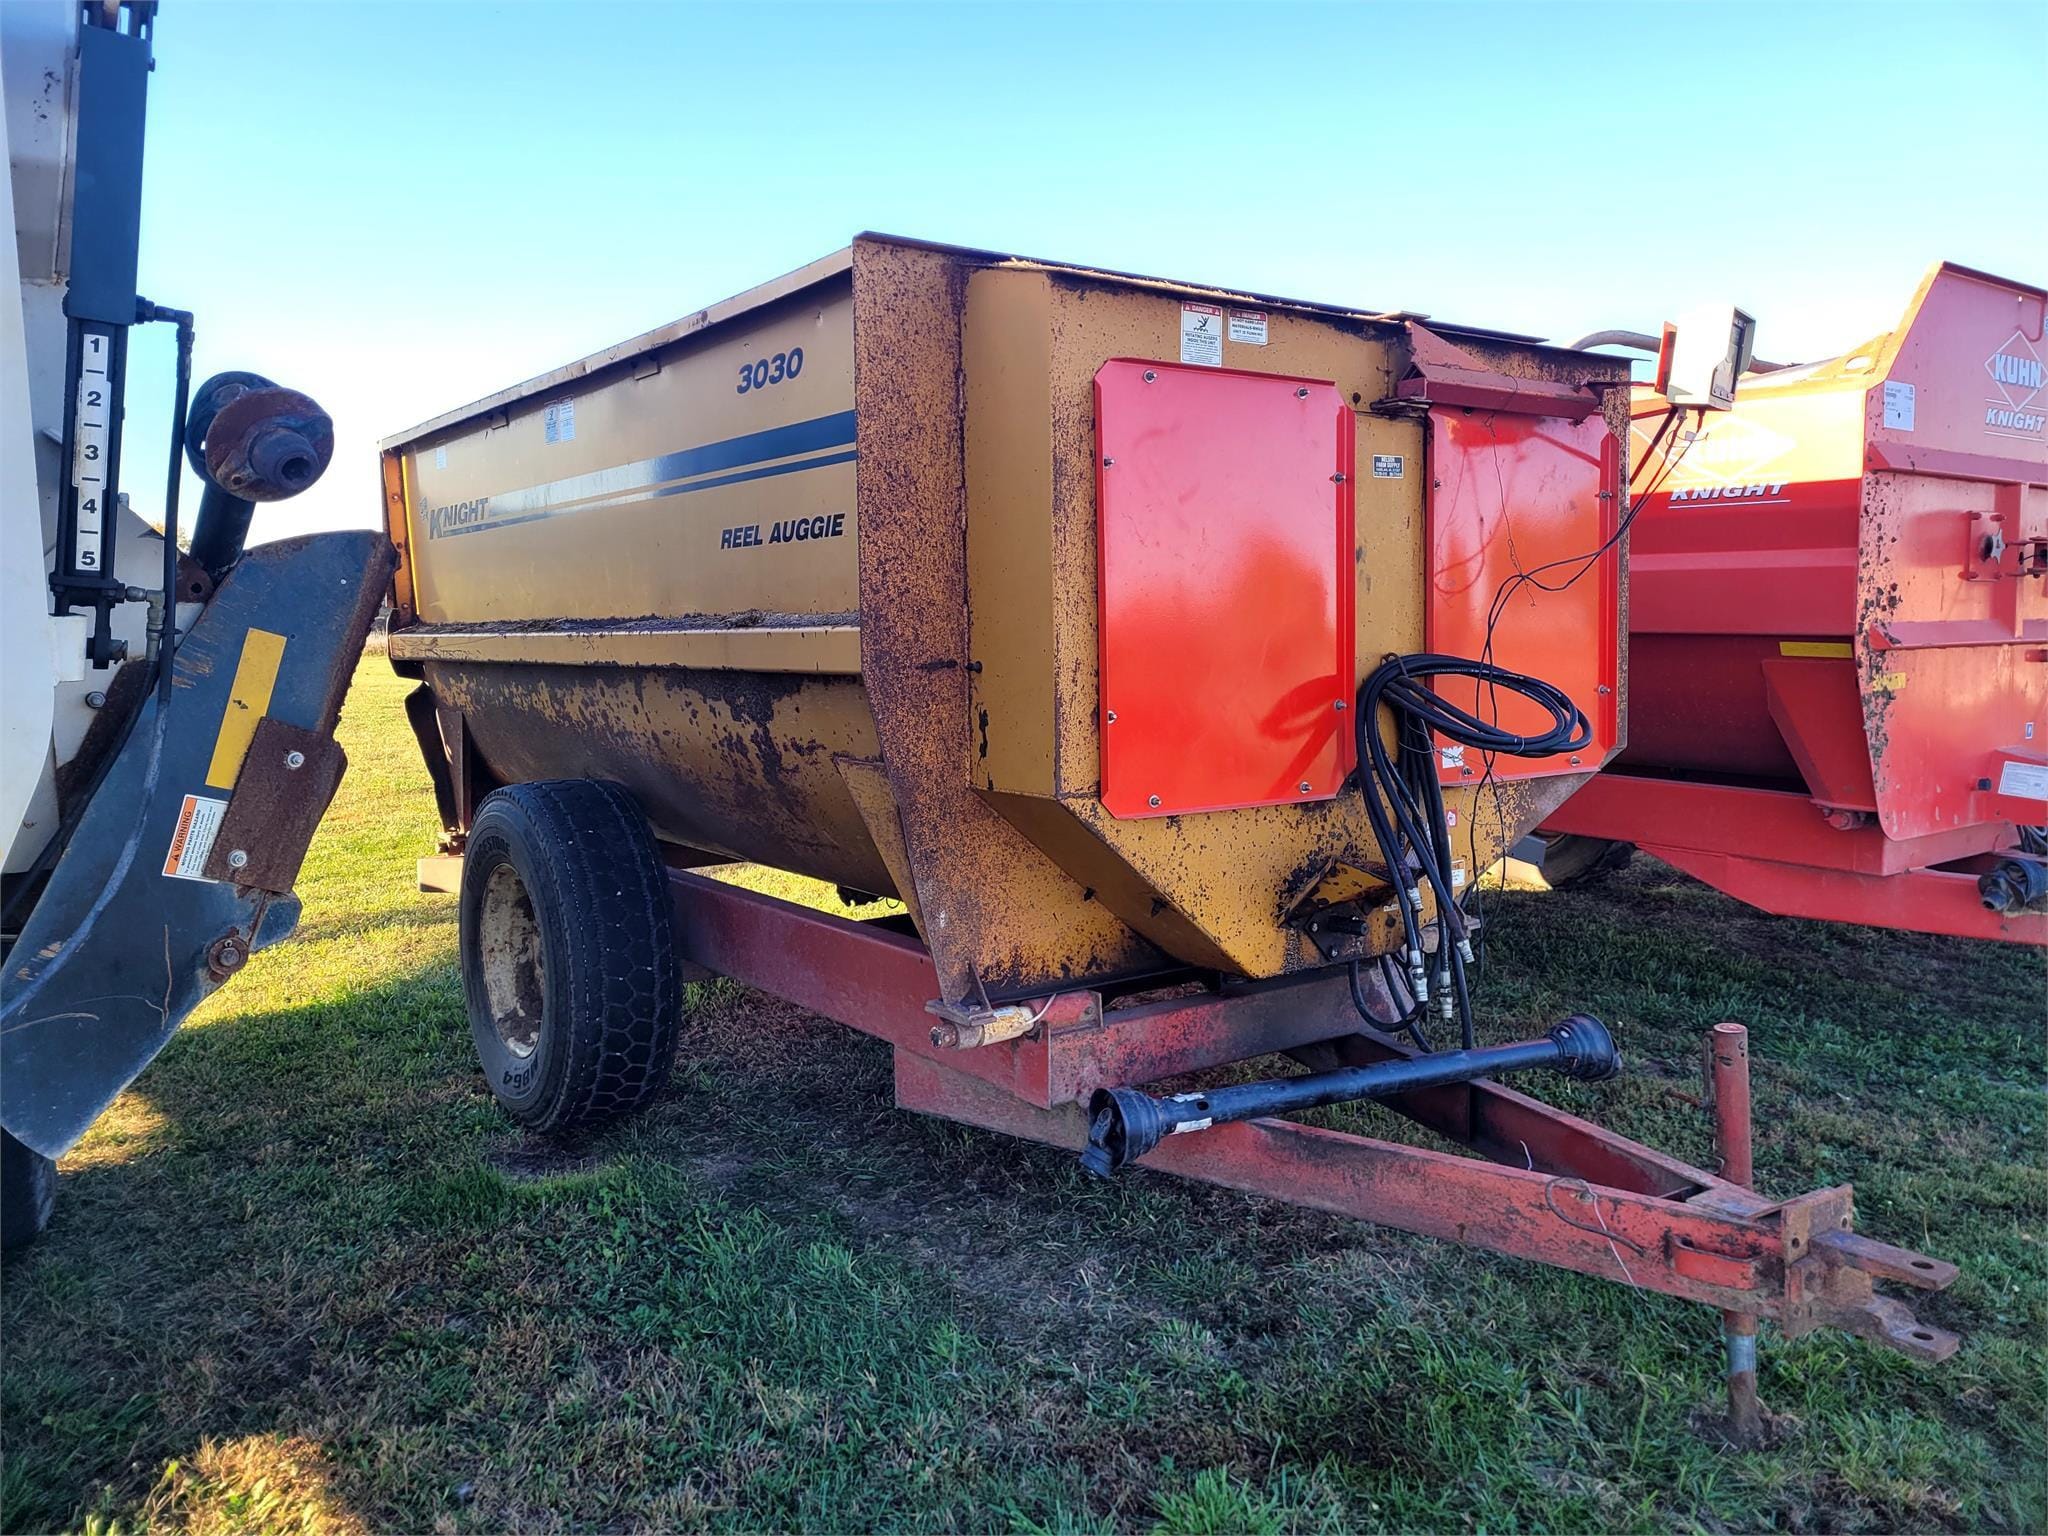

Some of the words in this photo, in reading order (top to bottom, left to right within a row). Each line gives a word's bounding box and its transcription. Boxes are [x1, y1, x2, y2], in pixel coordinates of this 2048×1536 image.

[1192, 304, 1212, 313] DANGER
[90, 338, 100, 352] 1
[736, 347, 803, 394] 3030
[1994, 353, 2041, 389] KUHN
[87, 391, 101, 406] 2
[1985, 408, 2046, 432] KNIGHT
[84, 444, 99, 460] 3
[1671, 480, 1790, 501] KNIGHT
[82, 499, 97, 513] 4
[430, 497, 488, 540] KNIGHT
[721, 525, 763, 549] REEL
[769, 513, 845, 544] AUGGIE
[81, 551, 96, 566] 5
[176, 811, 192, 851] WARNING
